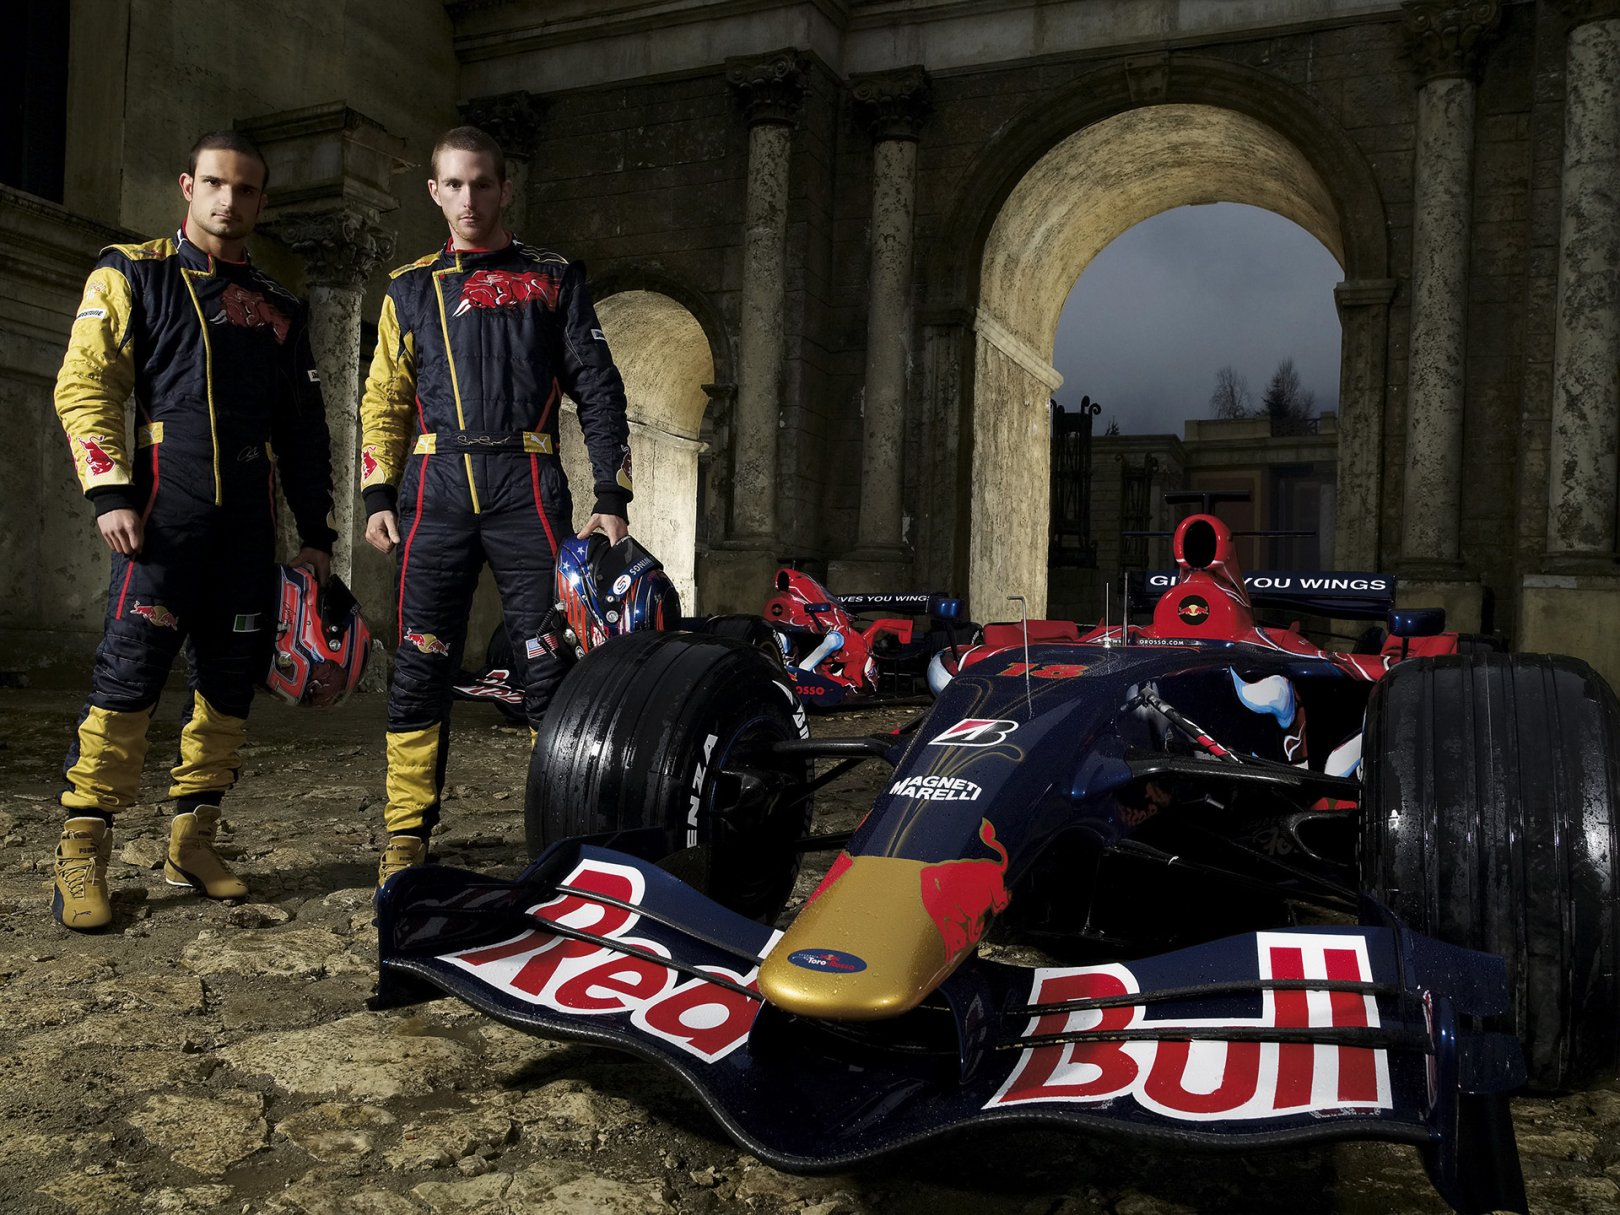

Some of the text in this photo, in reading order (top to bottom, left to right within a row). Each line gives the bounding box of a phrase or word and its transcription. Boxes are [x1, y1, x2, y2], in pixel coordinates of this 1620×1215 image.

[1299, 578, 1387, 591] WINGS
[794, 685, 825, 696] OSSO
[686, 733, 719, 849] ENZA
[889, 775, 982, 797] MAGNETI
[889, 782, 982, 801] MARELLI
[434, 858, 786, 1065] Red
[980, 930, 1394, 1122] Bull
